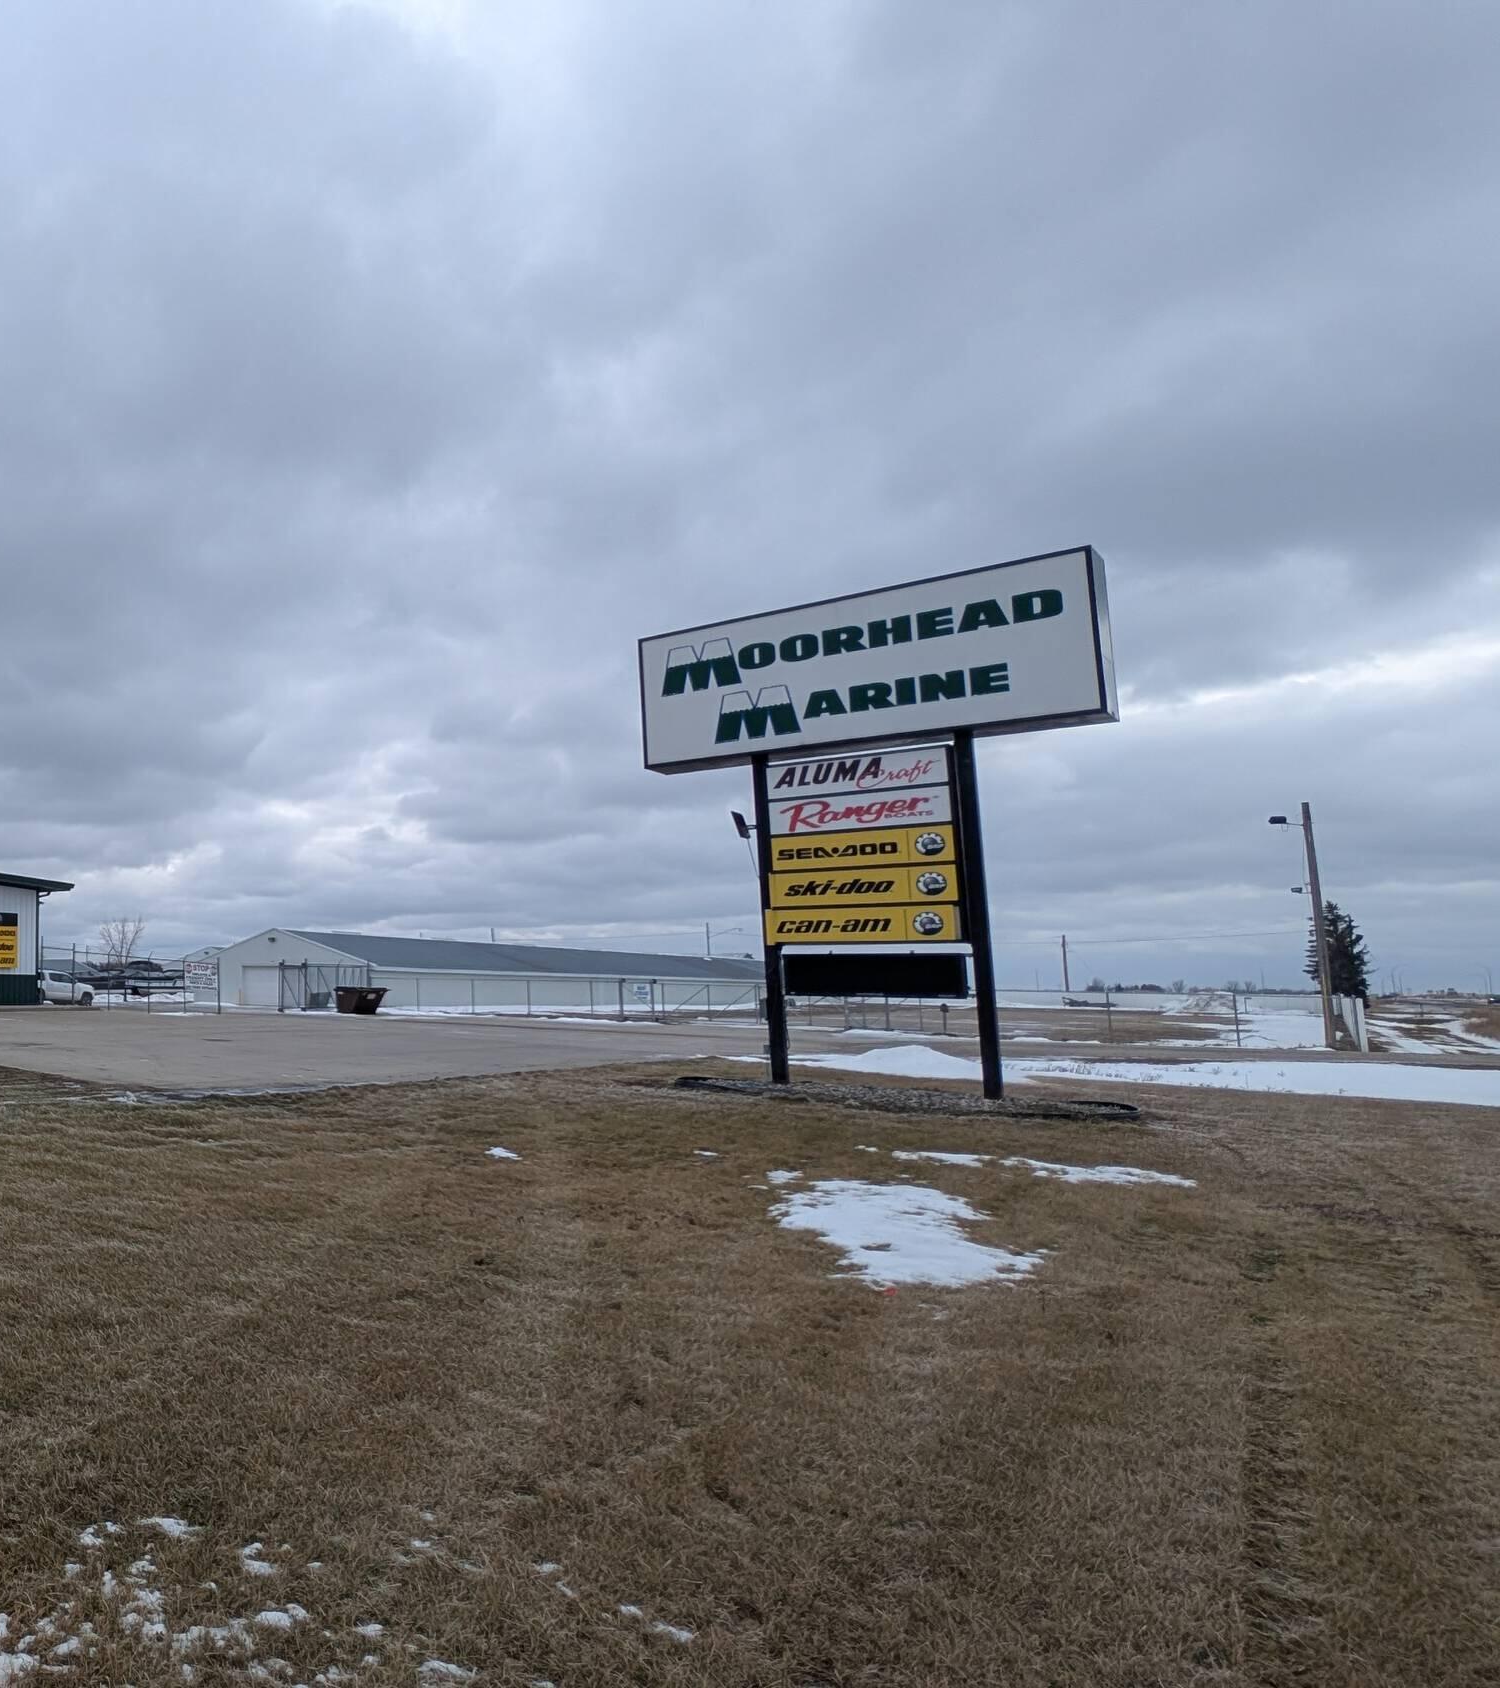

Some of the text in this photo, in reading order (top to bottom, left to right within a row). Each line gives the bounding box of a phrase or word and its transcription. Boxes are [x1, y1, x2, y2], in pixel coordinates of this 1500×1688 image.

[661, 588, 1063, 697] MOORHEAD
[714, 661, 1011, 744] MARINE
[780, 796, 930, 832] Ranger
[784, 878, 895, 896] ski-doo
[776, 918, 892, 933] can-am
